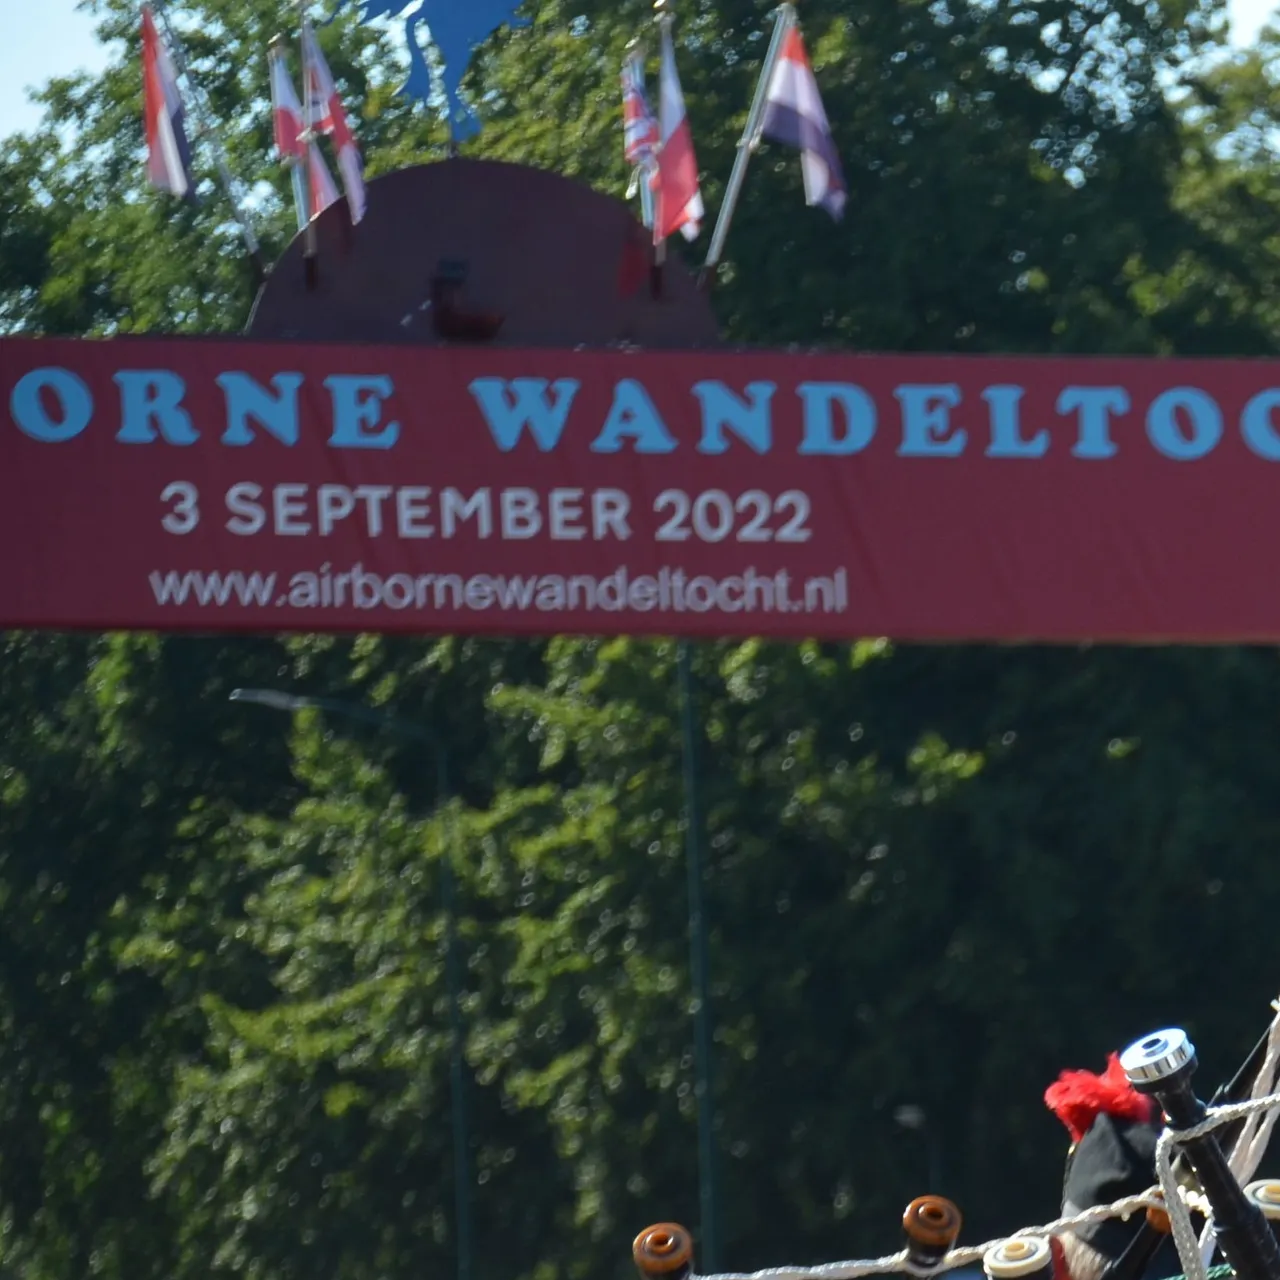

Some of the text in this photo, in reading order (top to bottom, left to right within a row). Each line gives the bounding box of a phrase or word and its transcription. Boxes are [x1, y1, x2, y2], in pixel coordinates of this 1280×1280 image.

[11, 367, 399, 449] ORNE
[160, 481, 813, 544] 3 SEPTEMBER 2022
[149, 562, 849, 615] www.airbornewandeltocht.nl
